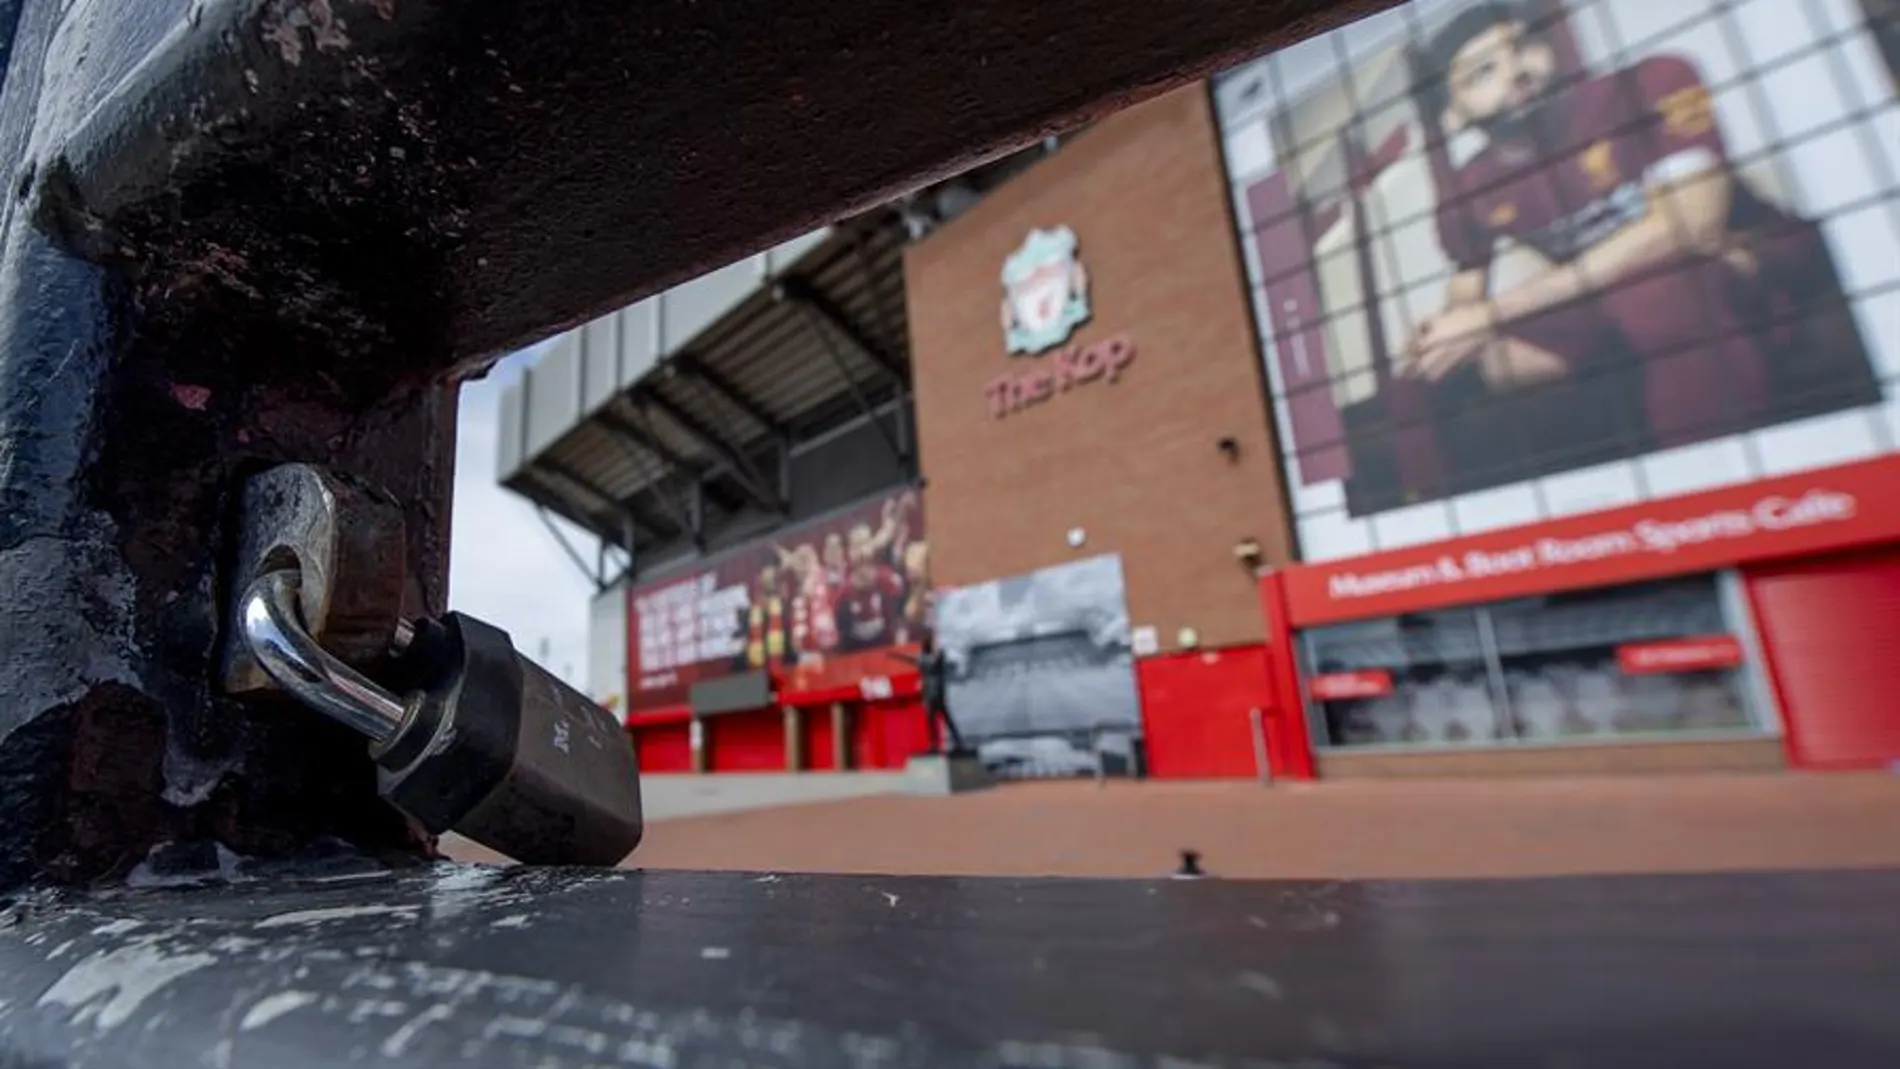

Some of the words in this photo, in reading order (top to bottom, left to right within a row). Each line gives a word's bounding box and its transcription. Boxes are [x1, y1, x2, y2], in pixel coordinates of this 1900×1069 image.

[985, 371, 1053, 418] The
[1053, 333, 1137, 392] Kop
[1329, 562, 1437, 598] Museum
[1437, 555, 1463, 582] &
[1464, 549, 1535, 580] Boot
[1536, 532, 1634, 563] Room
[1634, 509, 1753, 553] Sports
